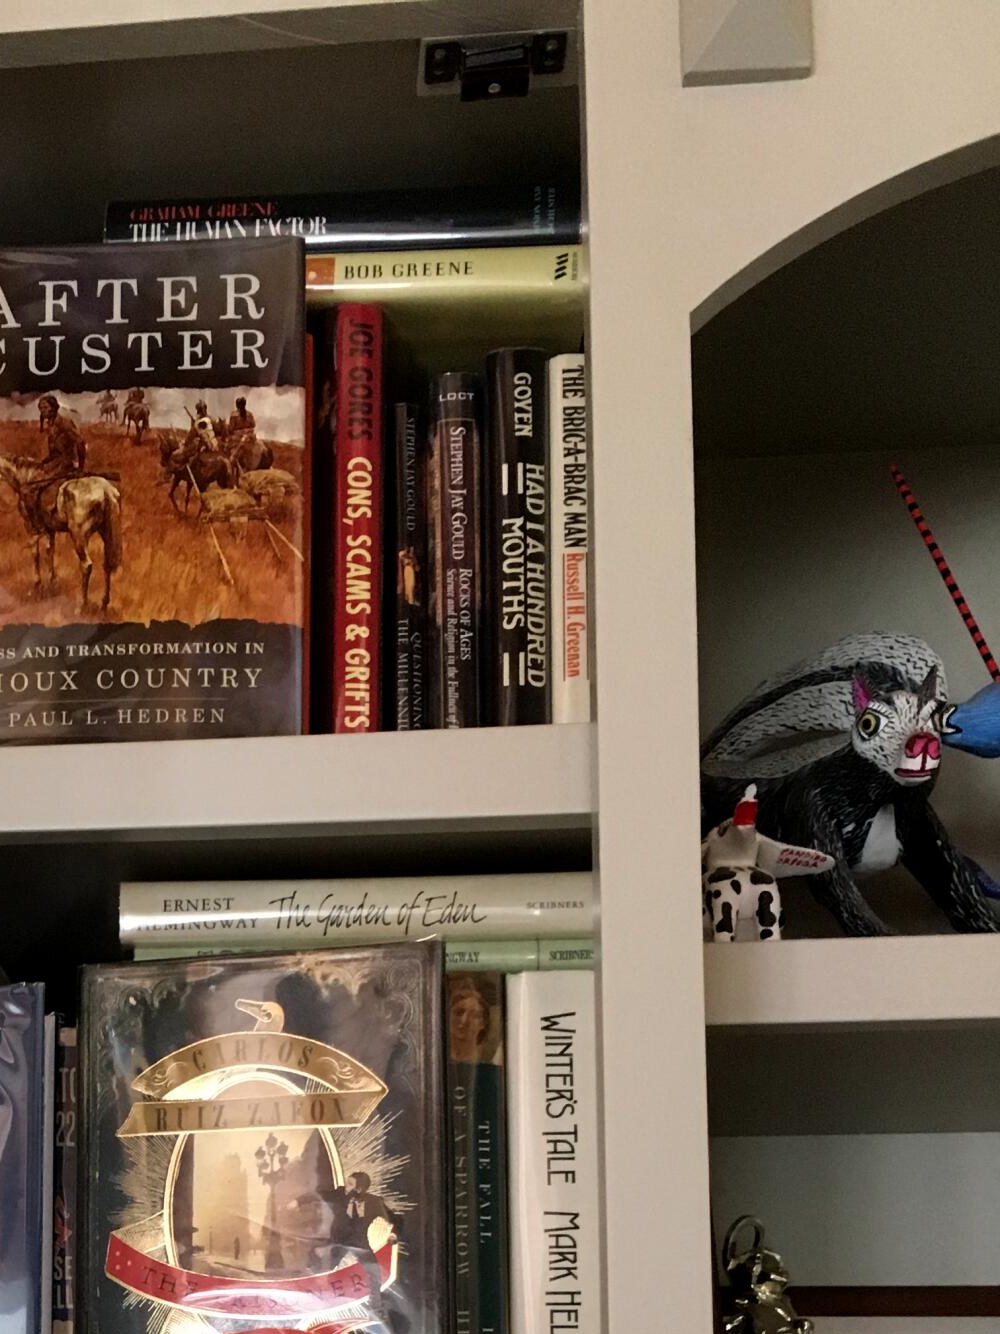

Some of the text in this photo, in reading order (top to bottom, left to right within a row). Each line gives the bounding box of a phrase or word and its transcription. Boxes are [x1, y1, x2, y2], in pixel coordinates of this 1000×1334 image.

[129, 201, 277, 221] GRAHAM GREENE
[129, 216, 328, 243] THE HUMAN FACTOR
[344, 260, 475, 281] BOB GREENE
[513, 372, 533, 438] GOYEN
[562, 365, 588, 549] THE BRIC-A-BRAC MAN
[404, 491, 418, 532] GOULD
[449, 426, 469, 560] STEPHEN JAY GOULD
[526, 463, 545, 515] HAD
[526, 538, 545, 556] A
[341, 457, 372, 729] CONS, SCAMS & GRIFTS
[502, 517, 525, 631] MOUTHS
[458, 568, 474, 661] ROCKS OF AGES
[526, 562, 547, 688] HUNDRED
[566, 552, 586, 678] Russell H. Greenan
[22, 646, 60, 658] AND
[66, 642, 238, 657] TRANSFORMATION
[244, 641, 265, 654] IN
[96, 667, 263, 689] COUNTRY
[9, 707, 226, 728] PAUL L. HEDREN
[162, 897, 235, 913] ERNEST
[268, 890, 488, 937] The Garden of Eden
[526, 901, 585, 911] SCRIBNERS
[193, 1037, 315, 1073] CARLOS
[156, 1104, 228, 1132] RUIZ
[541, 1012, 579, 1187] WINTER'S TALE
[452, 1085, 471, 1280] OF A SPARROW
[476, 1120, 493, 1246] THE FALL
[542, 1211, 580, 1281] MARK
[139, 1266, 200, 1297] THE
